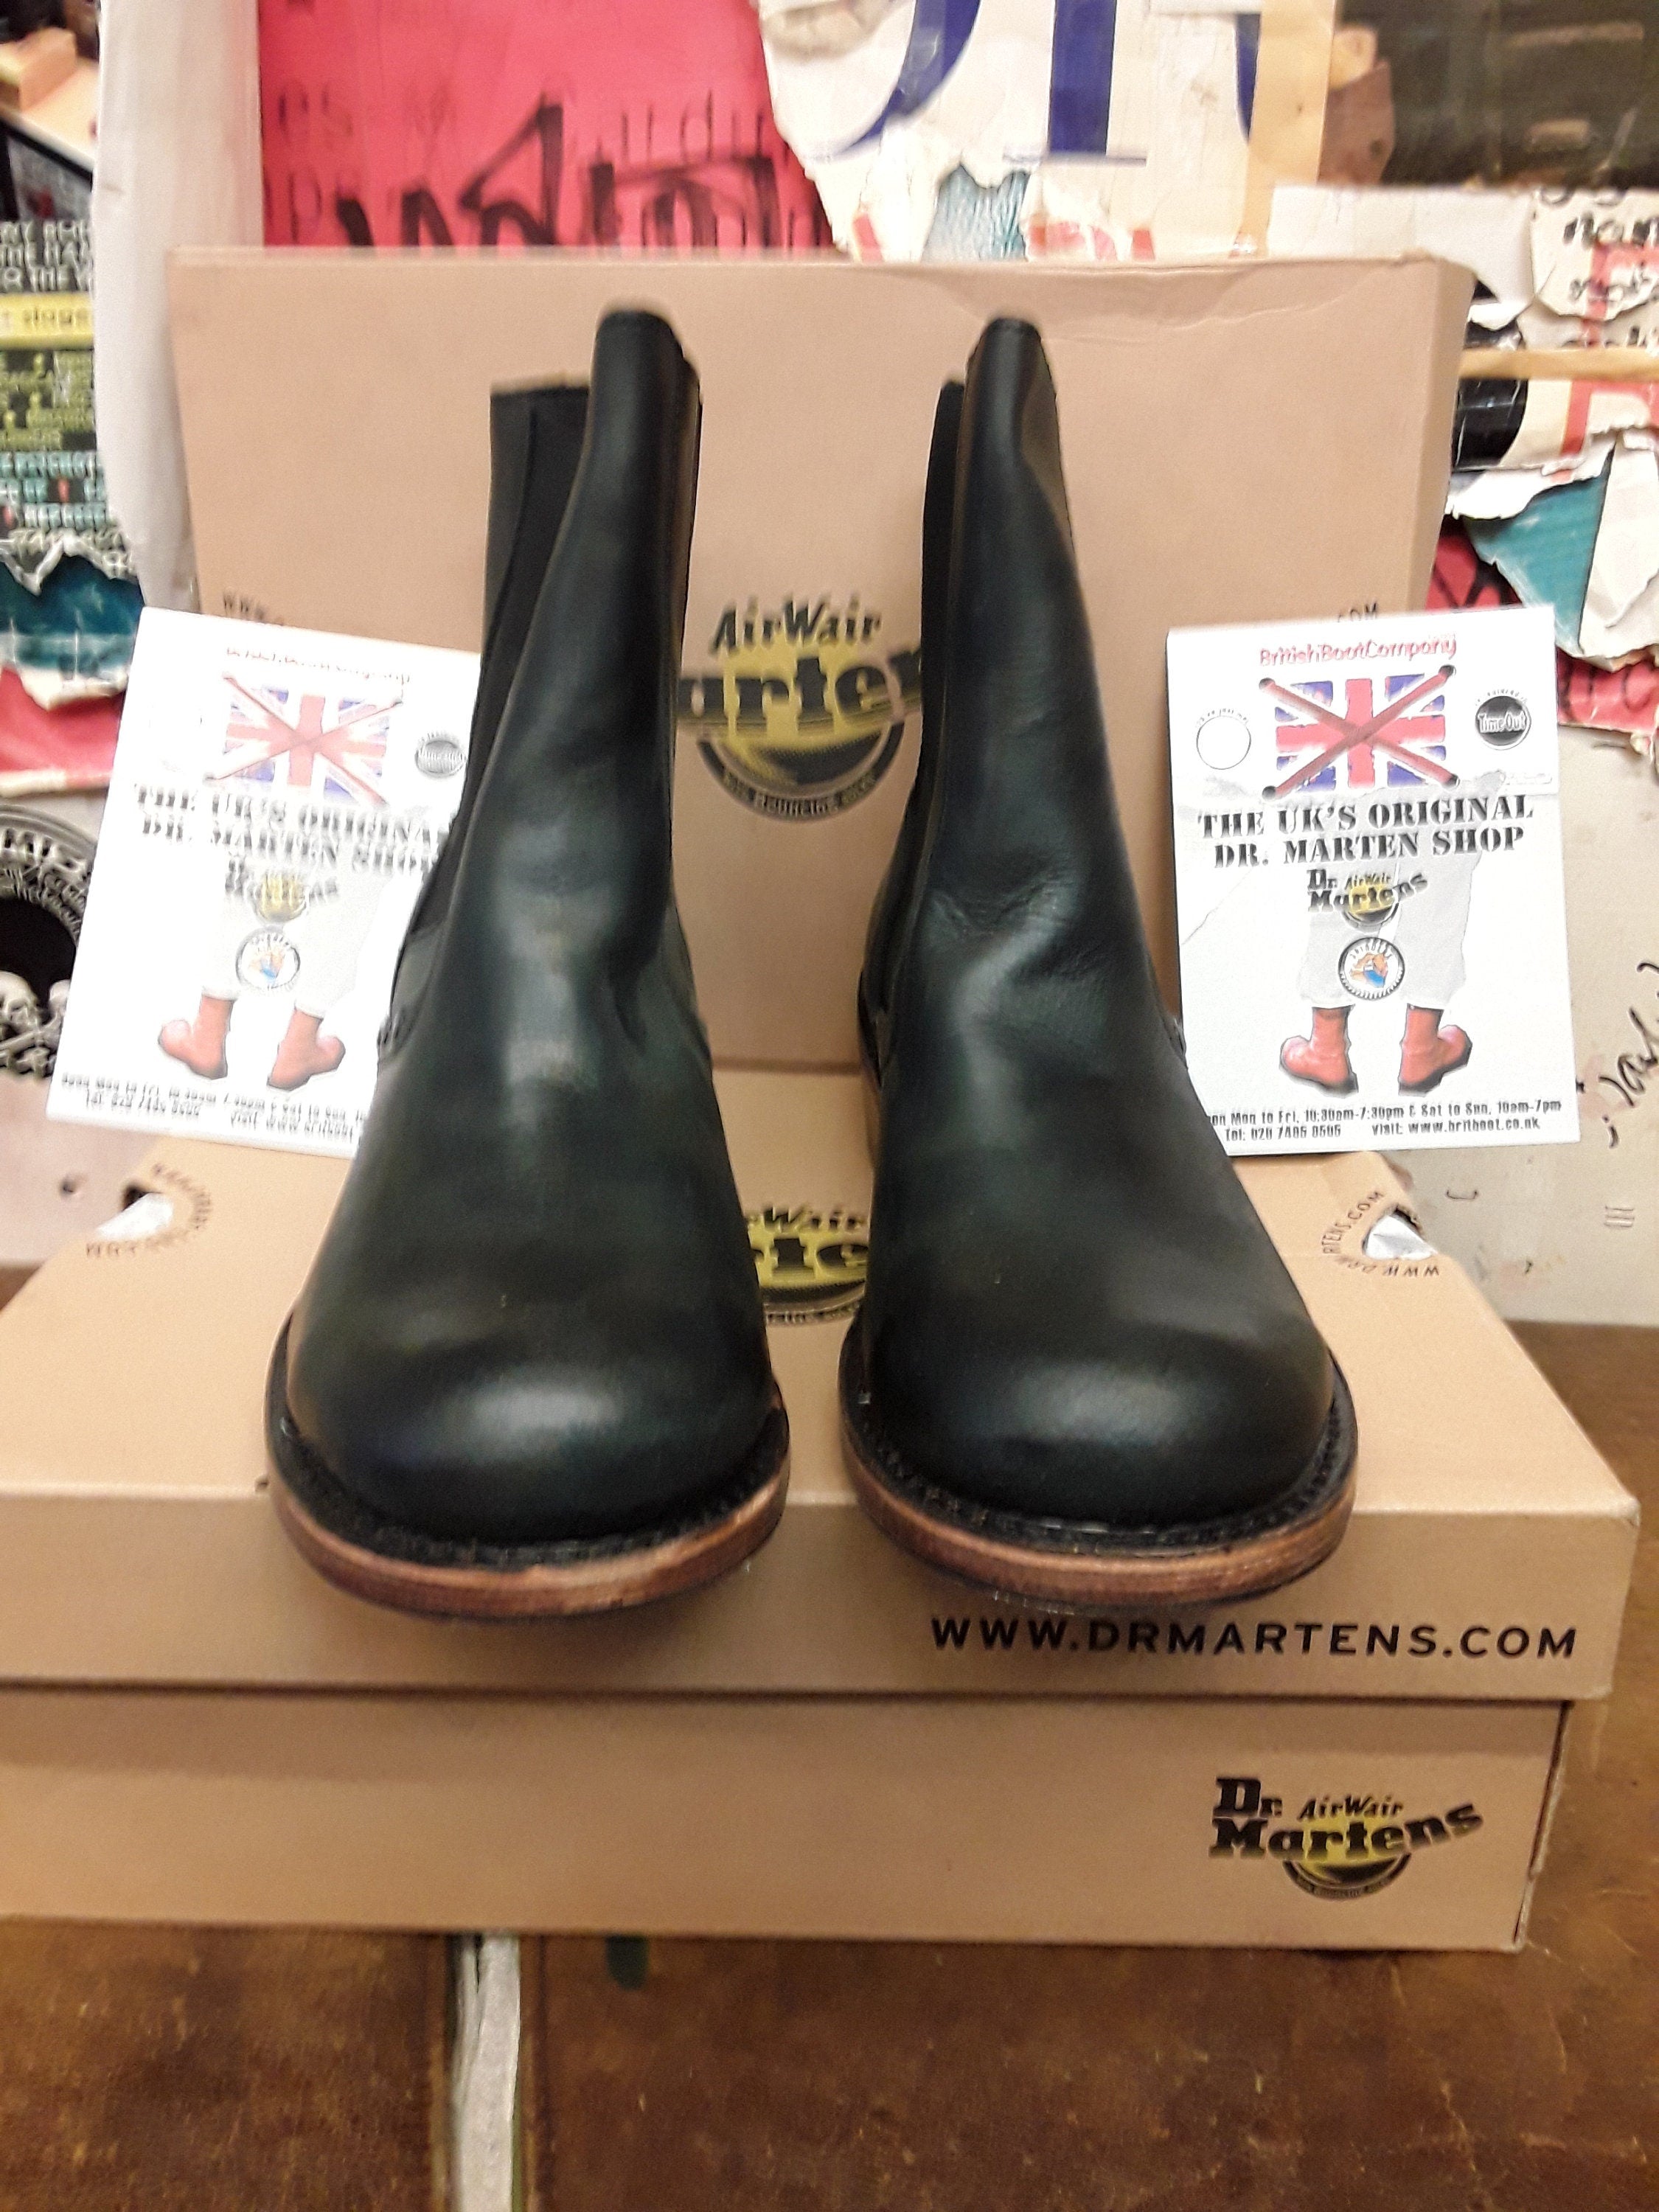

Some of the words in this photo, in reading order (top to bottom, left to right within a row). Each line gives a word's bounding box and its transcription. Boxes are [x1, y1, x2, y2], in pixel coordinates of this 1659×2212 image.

[709, 594, 883, 655] AirWair
[1197, 810, 1264, 838] THE
[1278, 804, 1357, 834] UK'S
[1368, 794, 1534, 830] ORIGINAL
[1214, 841, 1269, 868] DR.
[1283, 831, 1419, 864] MARTEN
[1433, 826, 1525, 855] SHOP
[1307, 873, 1429, 912] Martens
[1231, 1111, 1256, 1126] Mon
[1261, 1110, 1273, 1124] to
[1421, 1103, 1441, 1118] Sat
[1448, 1102, 1461, 1116] to
[931, 1617, 1578, 1659] WWW.DRMARTENS.COM
[1298, 1793, 1404, 1822] AirWair
[1208, 1802, 1484, 1860] Martens
